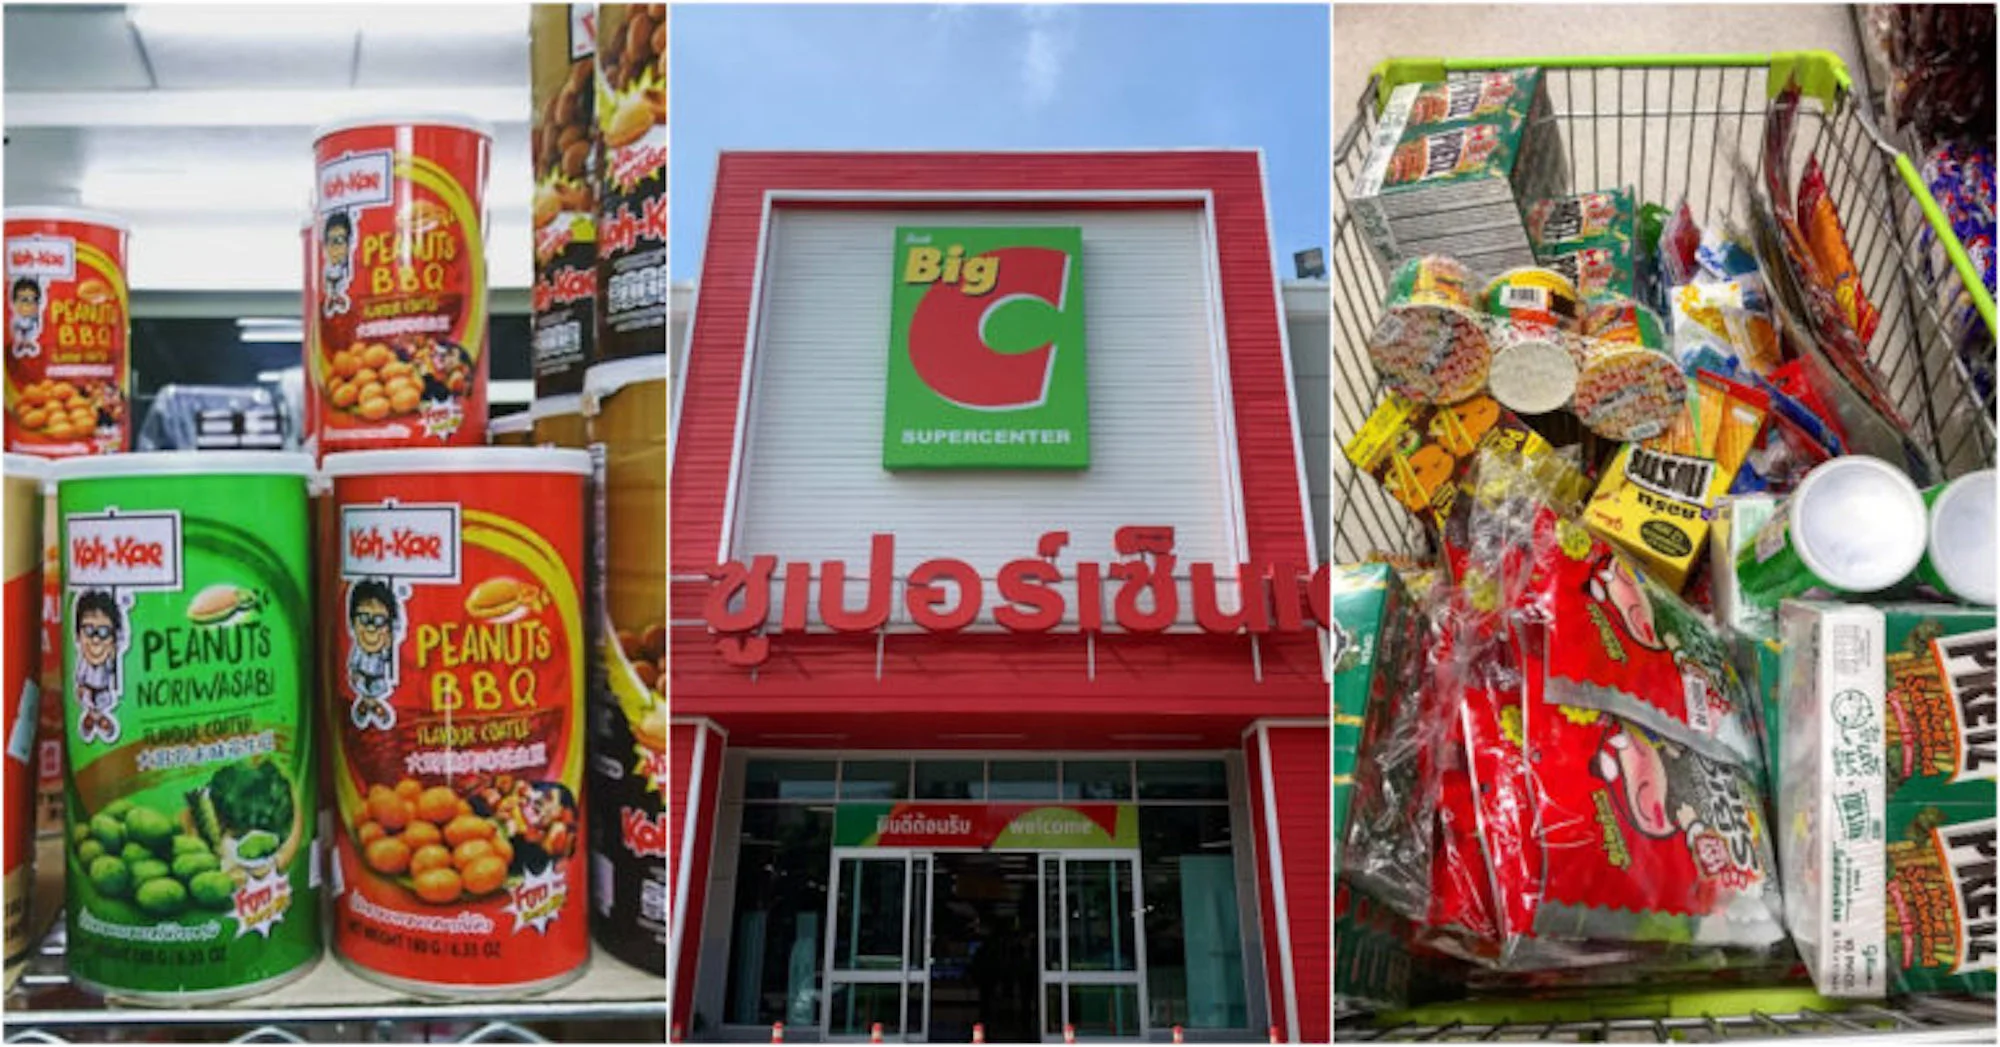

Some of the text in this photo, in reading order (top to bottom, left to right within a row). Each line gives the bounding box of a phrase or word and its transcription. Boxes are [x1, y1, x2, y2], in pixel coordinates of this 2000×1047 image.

[903, 245, 1071, 412] Big C
[902, 428, 1071, 446] SUPERCENTER
[73, 535, 164, 569] Koh-Kae
[350, 526, 442, 561] Koh-Kae
[142, 622, 272, 673] PEANUTS
[416, 619, 552, 669] PEANUTS
[1010, 815, 1091, 835] welcome
